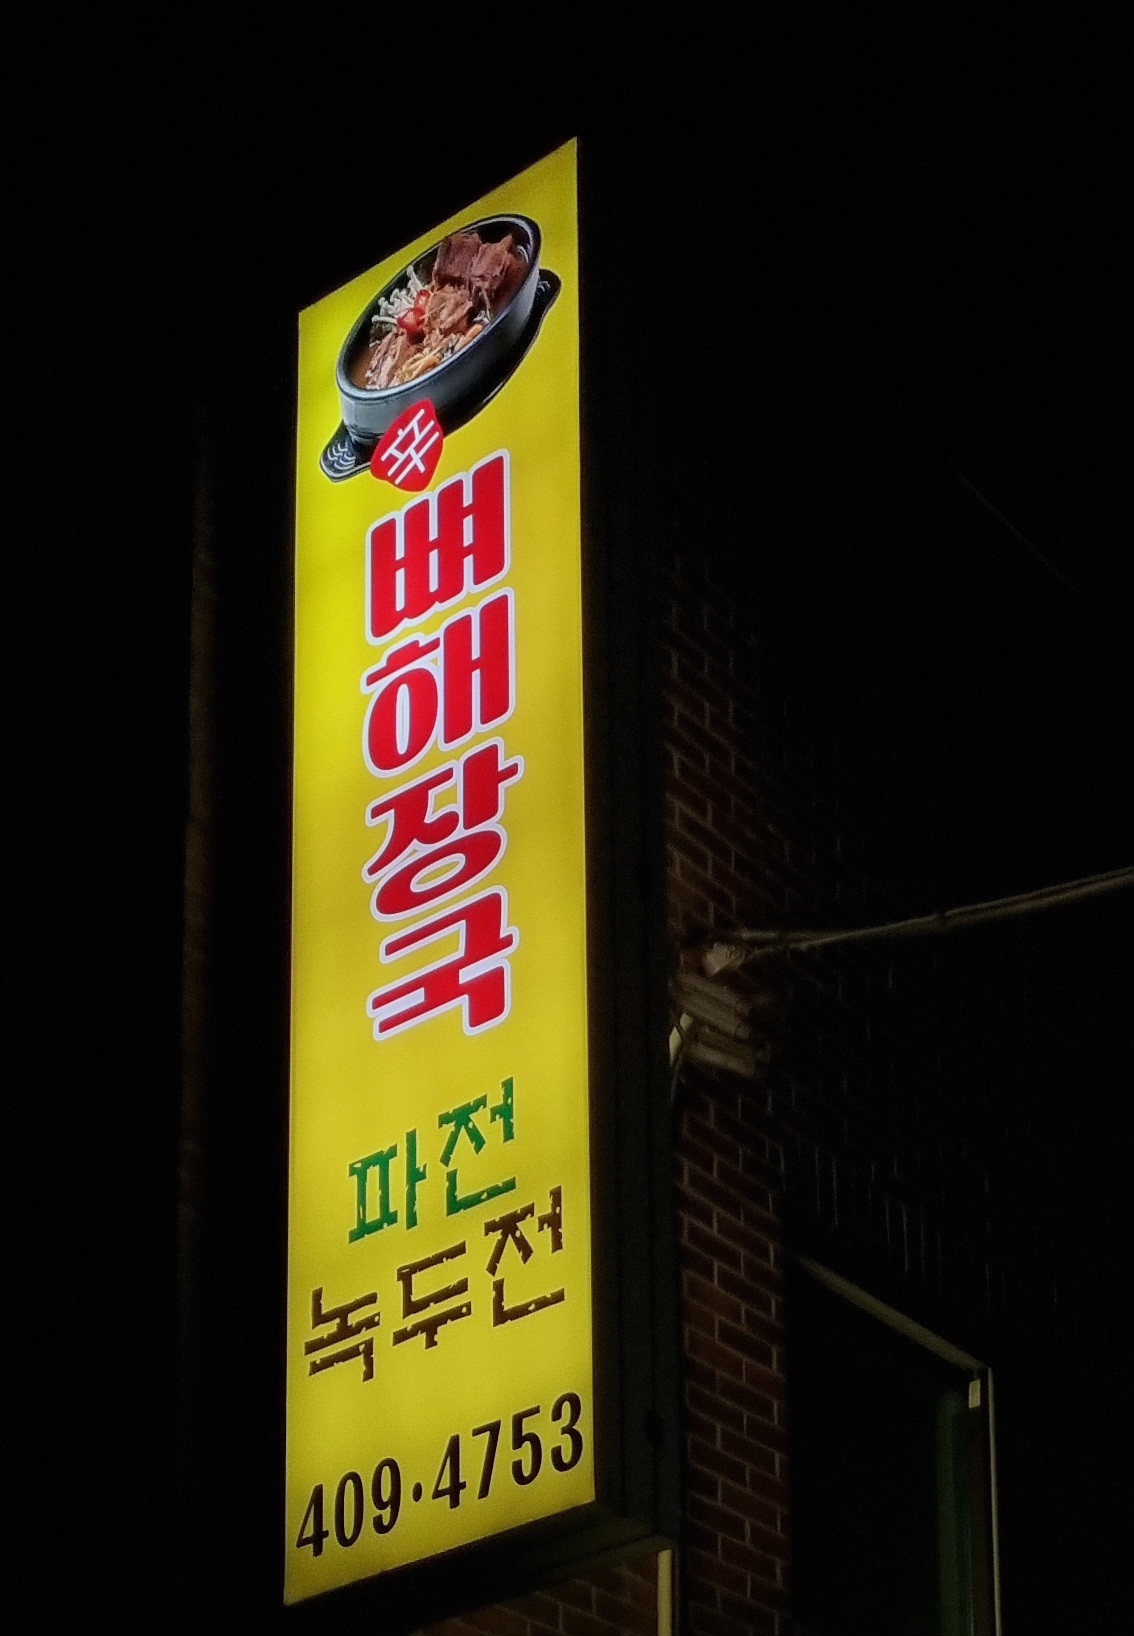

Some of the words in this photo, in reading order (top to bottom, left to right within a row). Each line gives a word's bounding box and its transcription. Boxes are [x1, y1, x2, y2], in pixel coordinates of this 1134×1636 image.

[362, 449, 522, 1039] 뼈해장국
[348, 1076, 516, 1244] 파전
[304, 1185, 565, 1382] 녹두전
